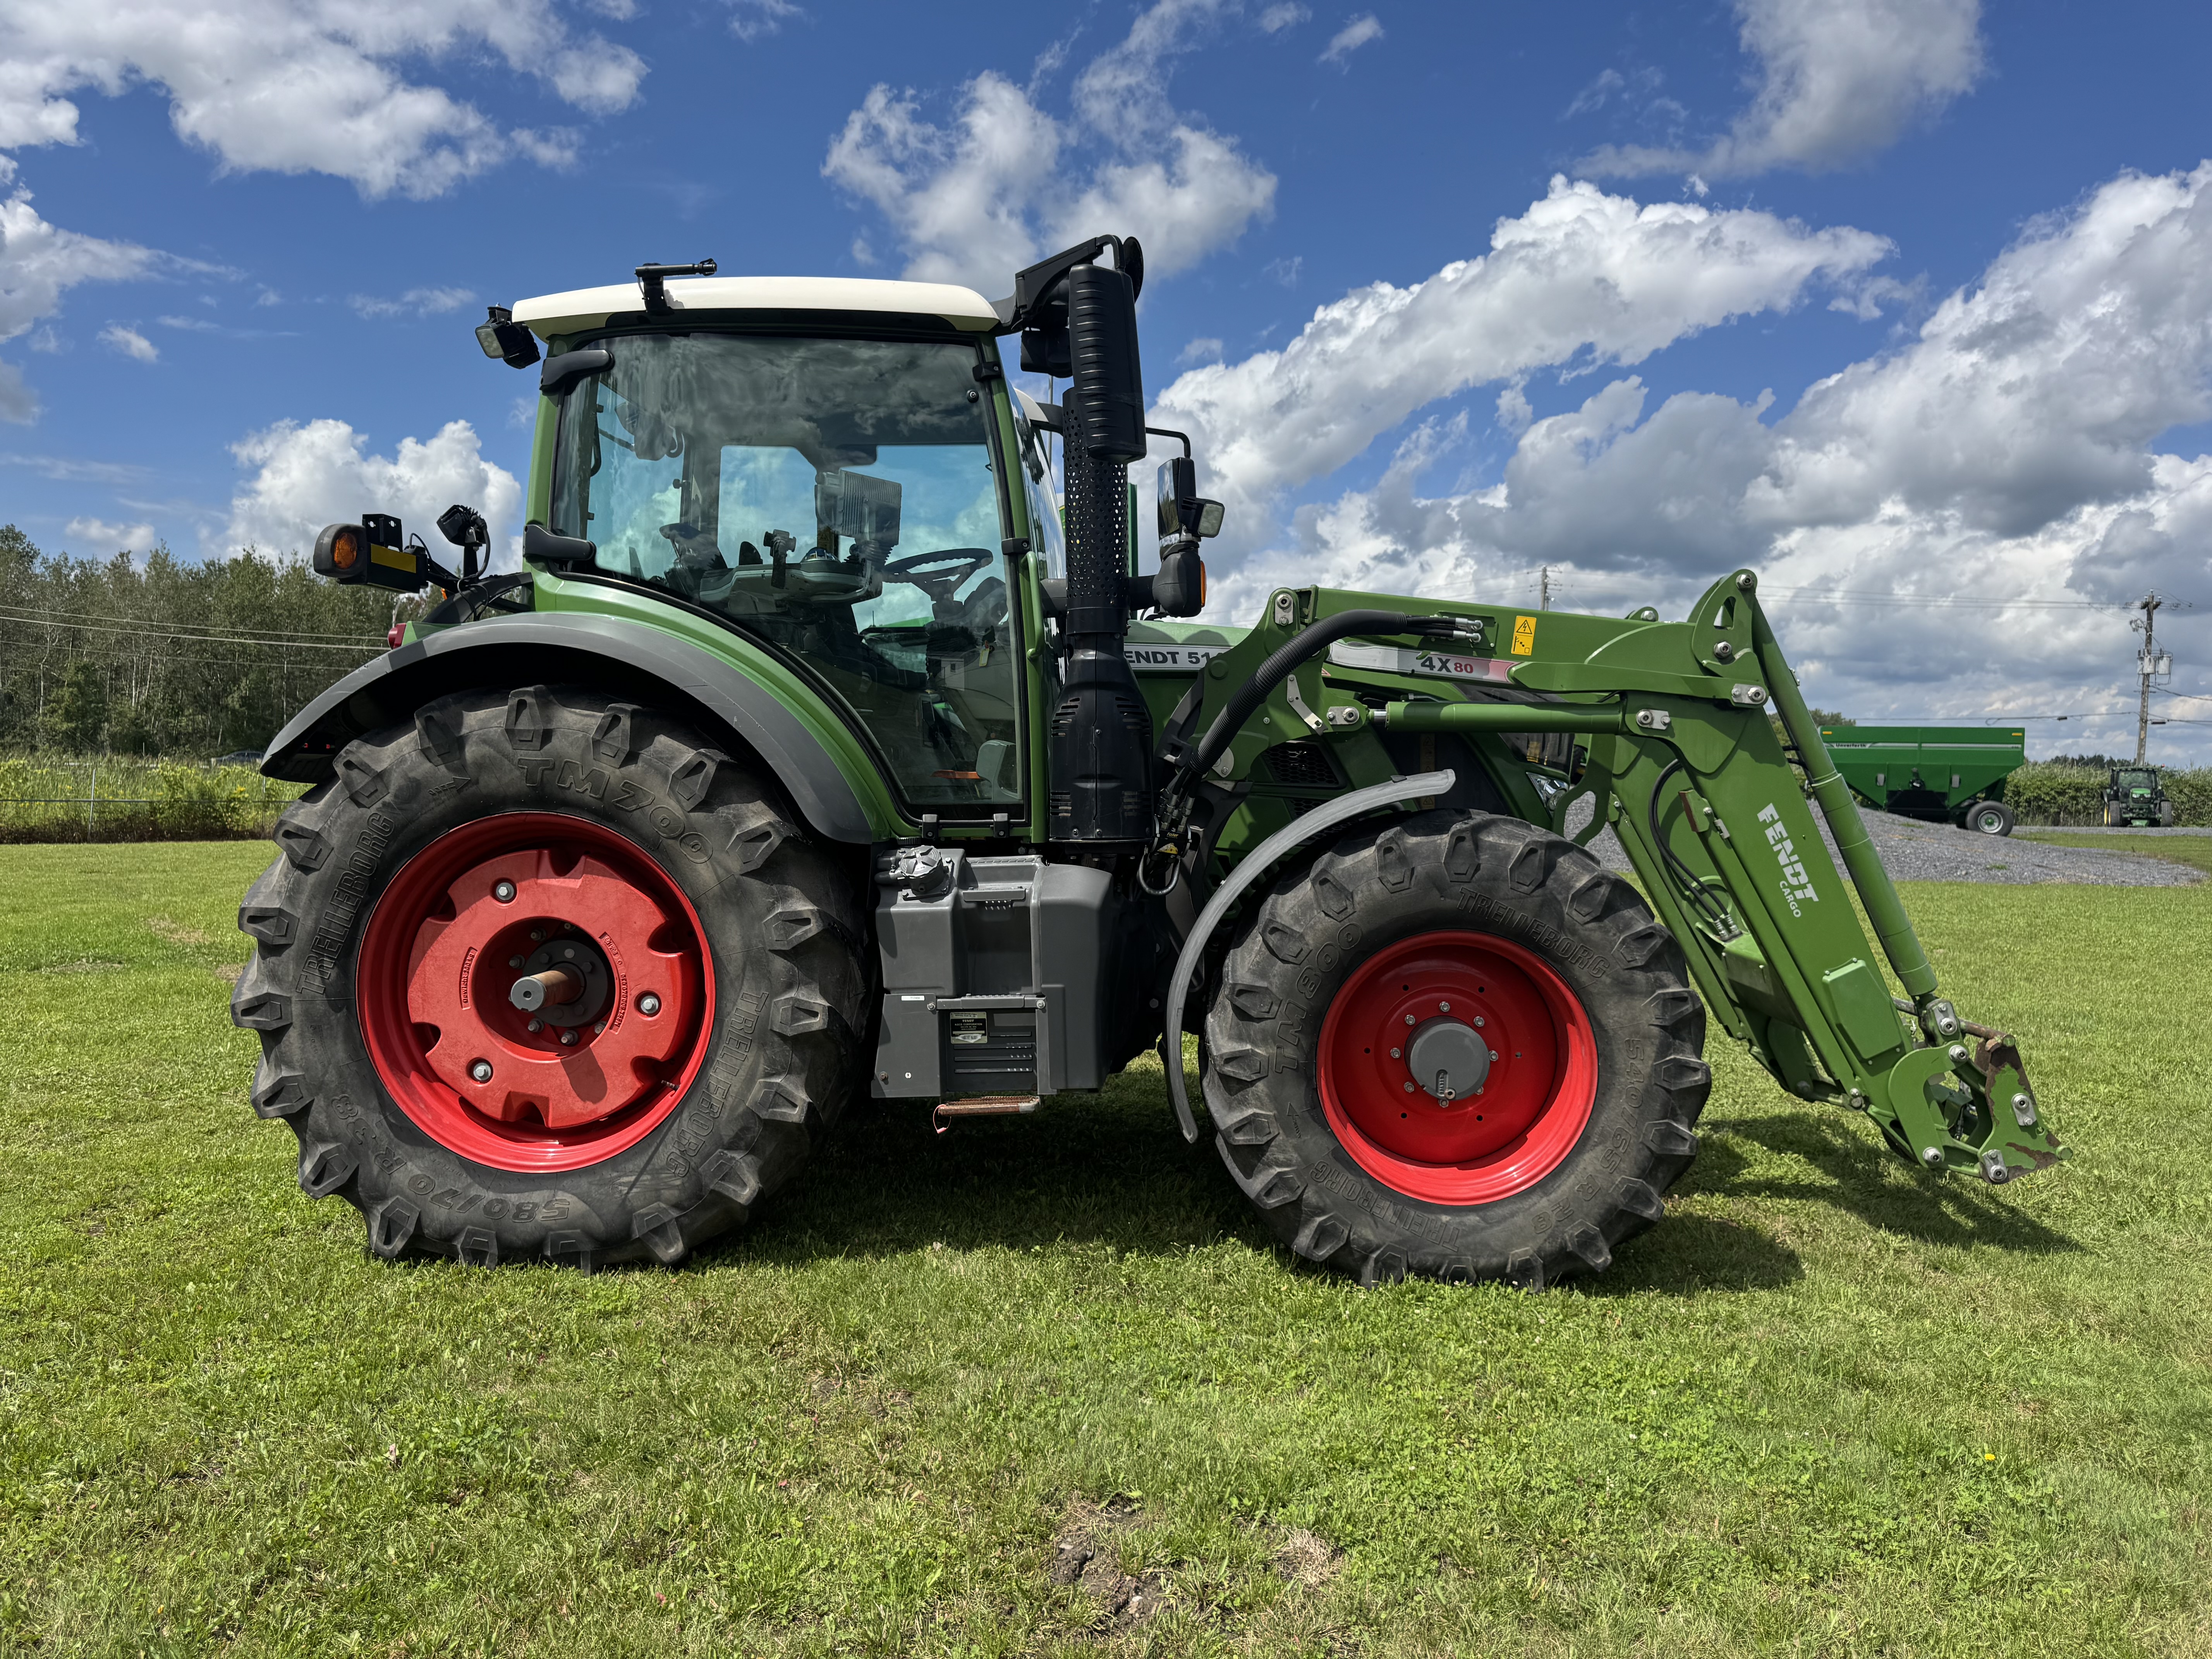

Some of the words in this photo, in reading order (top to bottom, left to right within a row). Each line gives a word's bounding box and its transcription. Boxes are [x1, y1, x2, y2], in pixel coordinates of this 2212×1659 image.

[1124, 651, 1179, 664] ENDT
[1187, 652, 1223, 665] 51
[1757, 803, 1819, 902] FENDT
[295, 812, 394, 994] TRELLEBORG
[1456, 886, 1610, 978] TRELLEBORG
[1779, 880, 1802, 918] CARGO
[666, 991, 769, 1178] TRELLEBORG
[1600, 1038, 1645, 1174] 540/65
[408, 1174, 570, 1223] 580/70
[1309, 1161, 1460, 1252] TRELLEBORG
